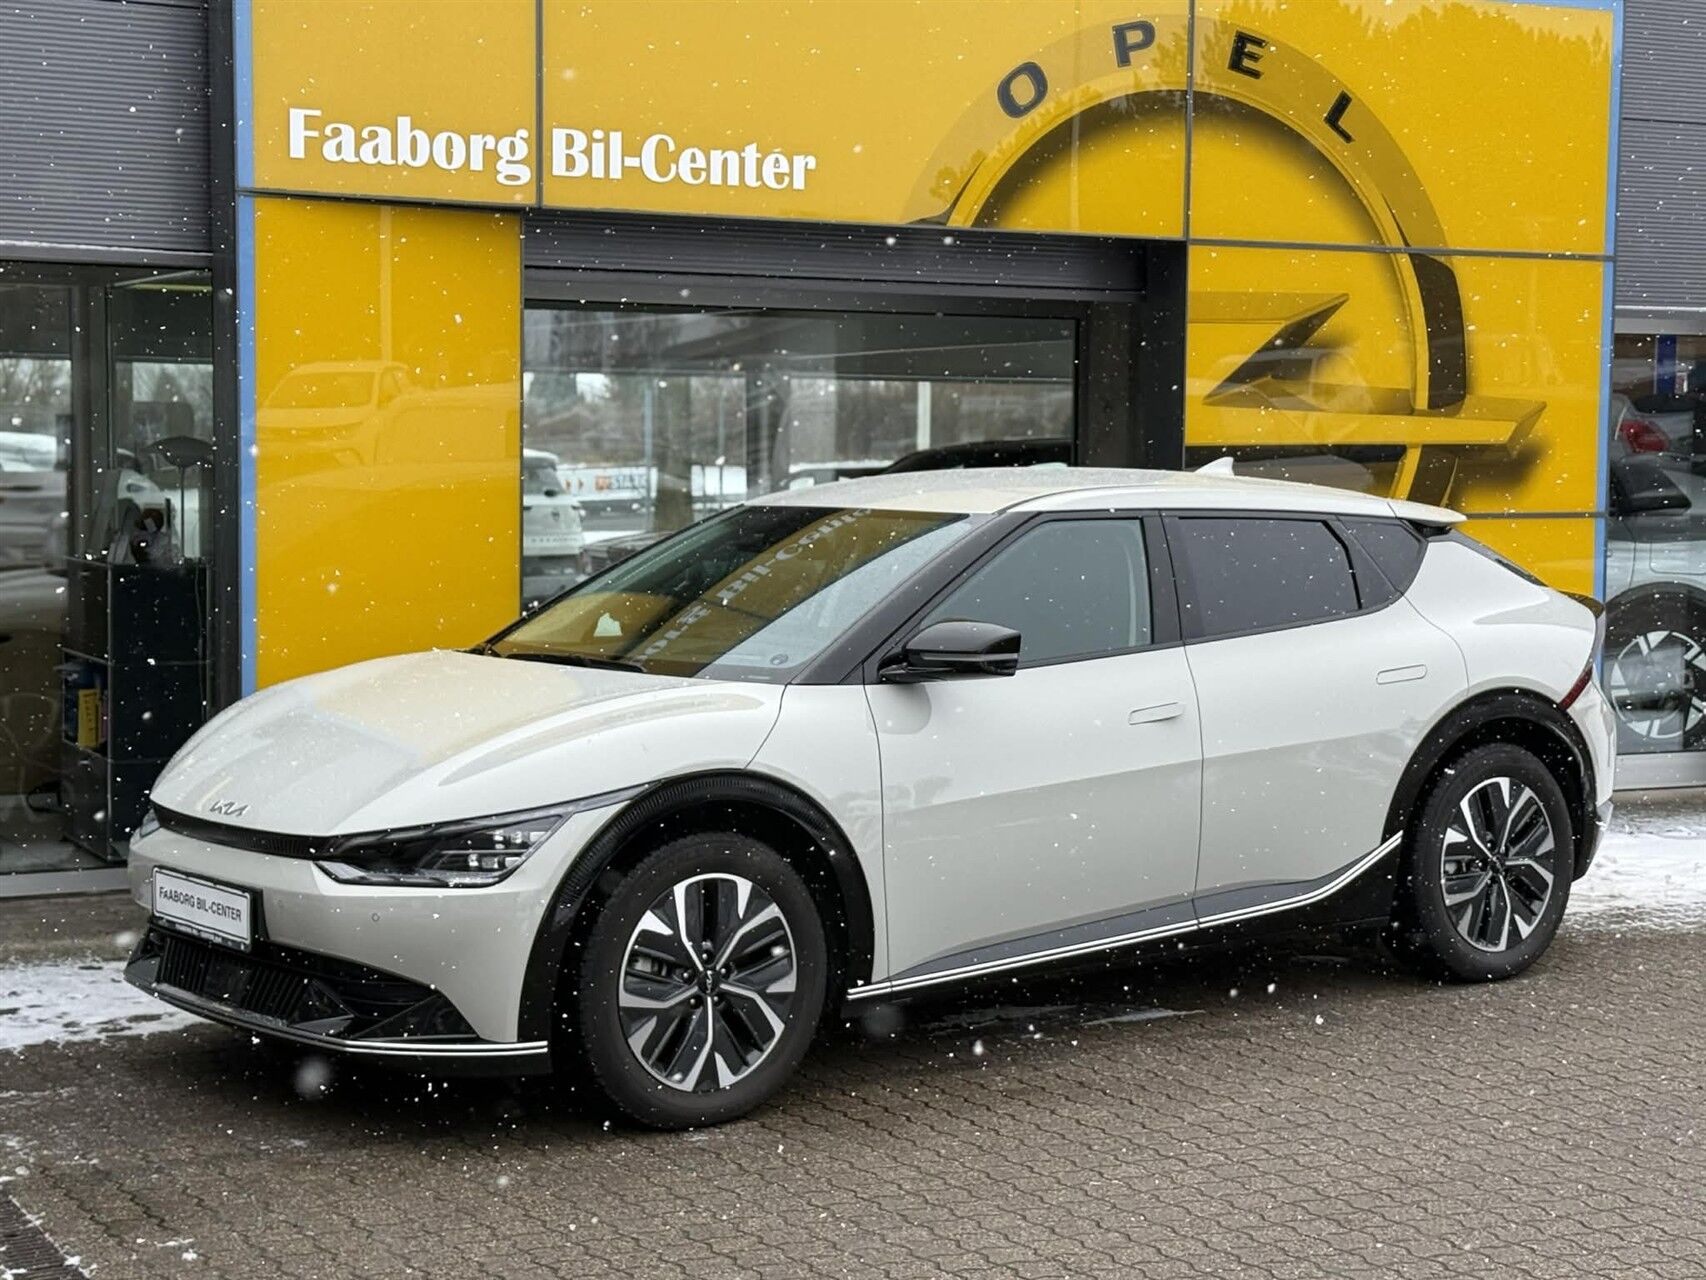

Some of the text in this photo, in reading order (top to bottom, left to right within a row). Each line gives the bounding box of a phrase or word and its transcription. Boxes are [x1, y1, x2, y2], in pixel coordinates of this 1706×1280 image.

[997, 20, 1355, 144] OPEL
[289, 107, 816, 190] Faaborg Bil-Center
[196, 896, 242, 922] BIL-CENTER
